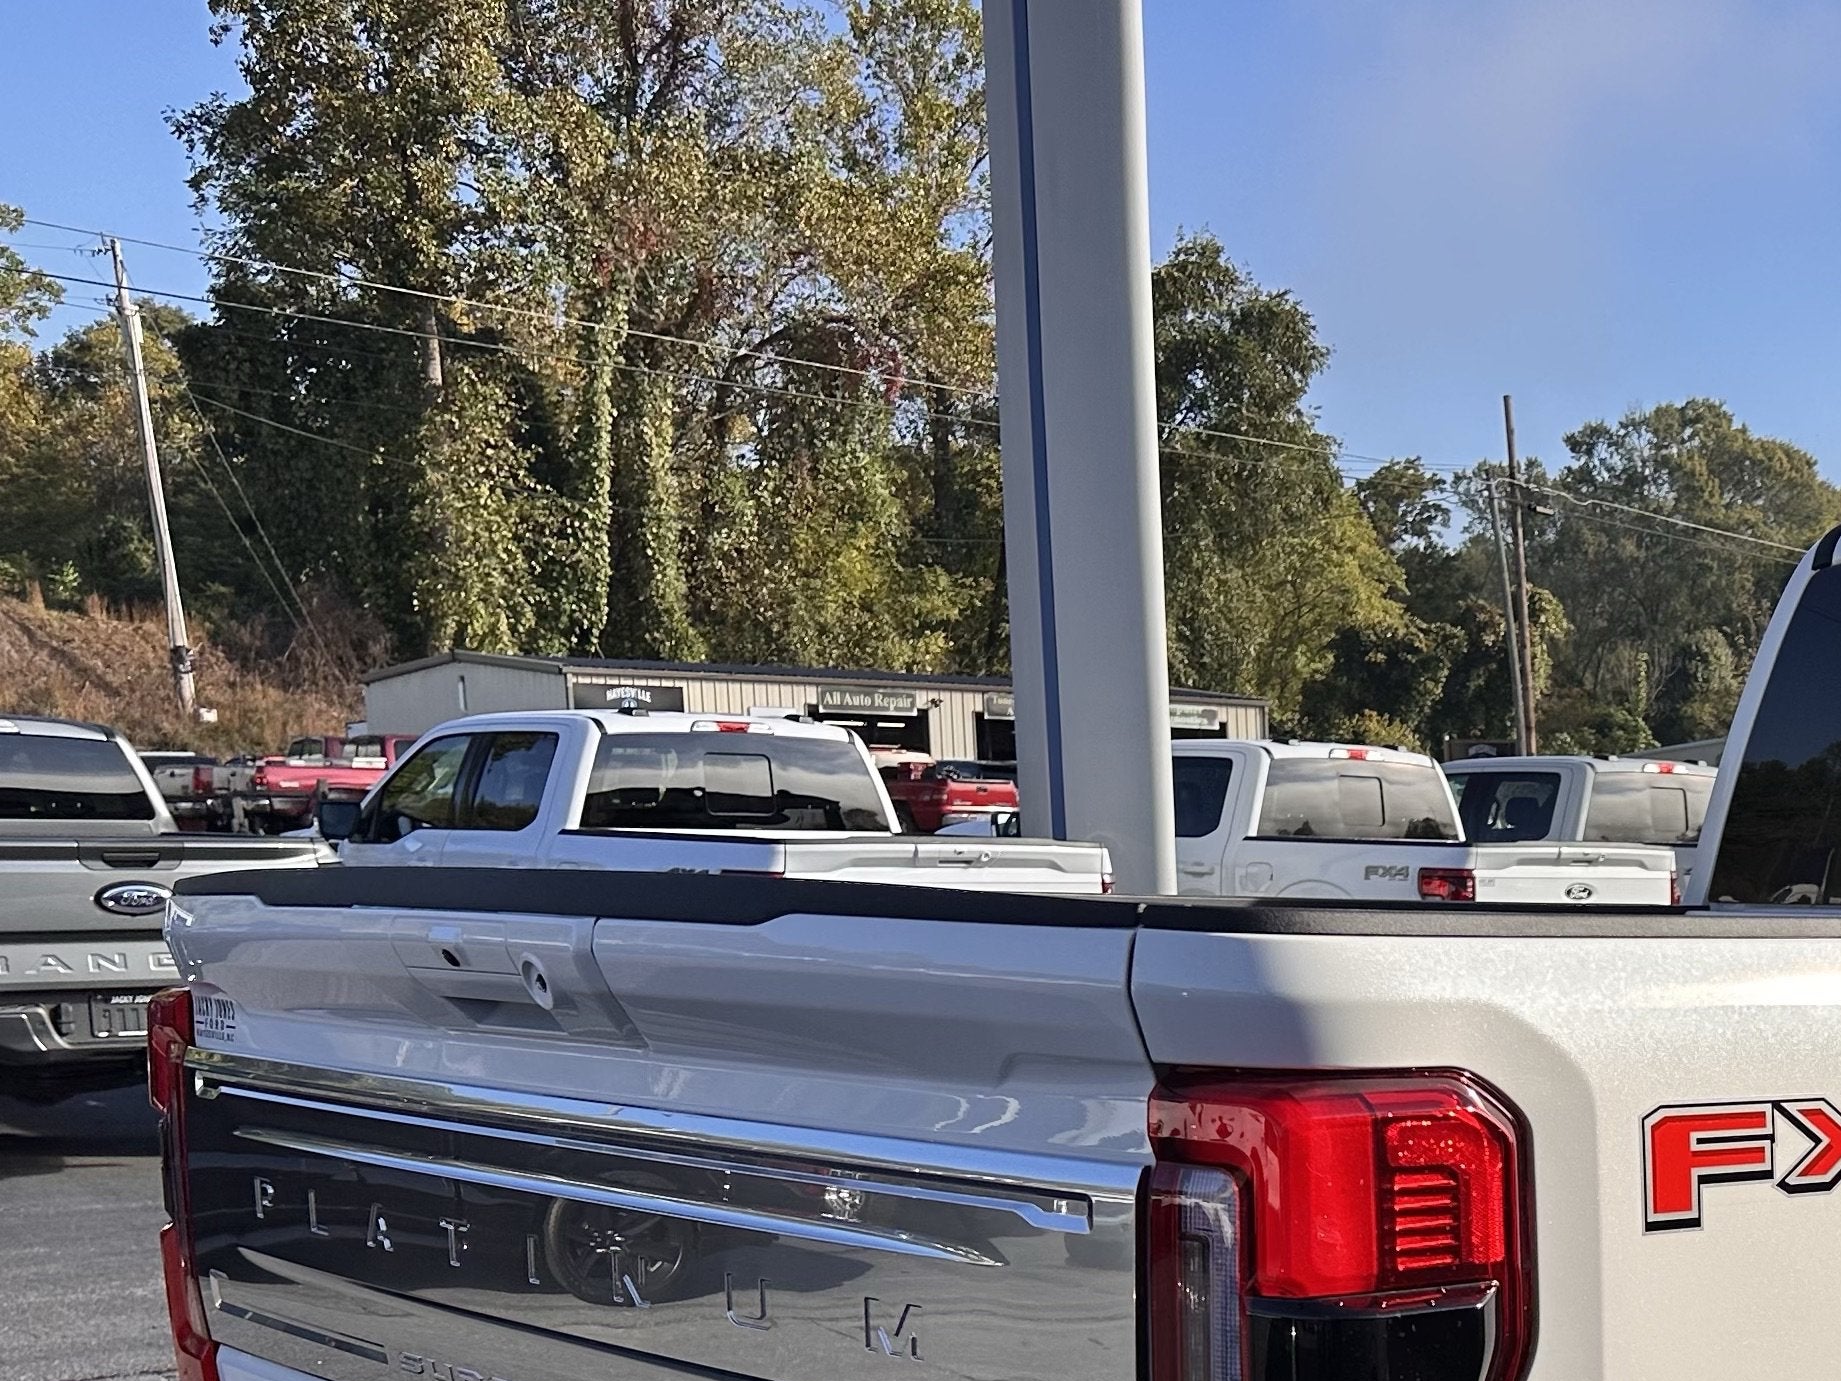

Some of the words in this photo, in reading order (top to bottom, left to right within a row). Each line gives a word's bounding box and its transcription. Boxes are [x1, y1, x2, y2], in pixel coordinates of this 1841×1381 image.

[823, 691, 841, 706] All
[843, 693, 873, 707] Auto
[874, 694, 913, 709] Repair
[1364, 865, 1410, 881] FX4
[0, 952, 178, 974] ANG
[204, 1018, 225, 1030] FORD
[253, 1175, 926, 1362] PLATINUM
